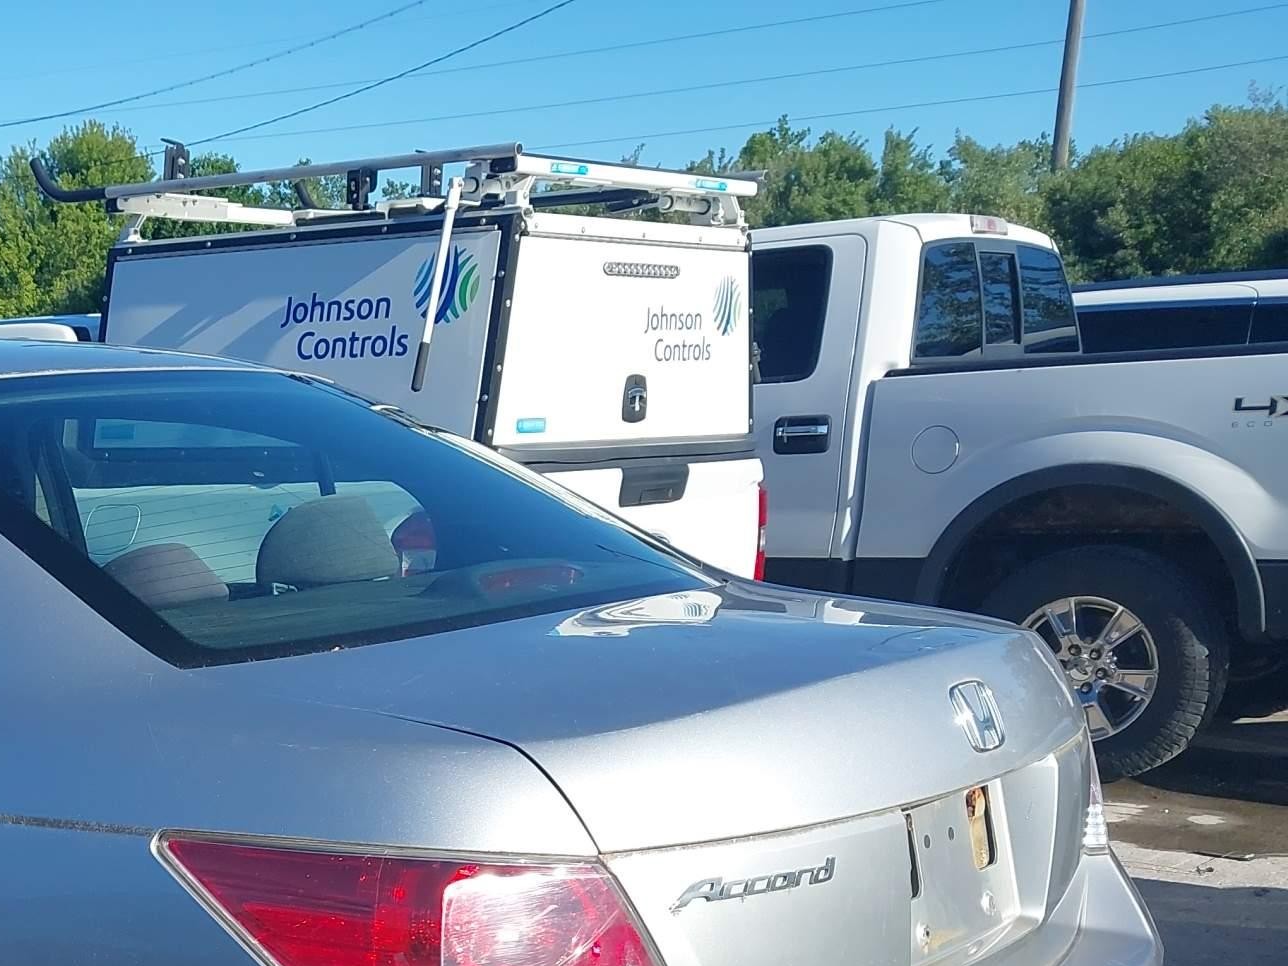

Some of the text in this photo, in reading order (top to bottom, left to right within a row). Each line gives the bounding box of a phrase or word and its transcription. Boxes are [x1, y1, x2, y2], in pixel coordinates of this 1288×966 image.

[280, 292, 391, 329] Johnson
[644, 304, 702, 334] Johnson
[297, 325, 409, 360] Controls
[654, 335, 712, 362] Controls
[669, 856, 836, 914] Accord
